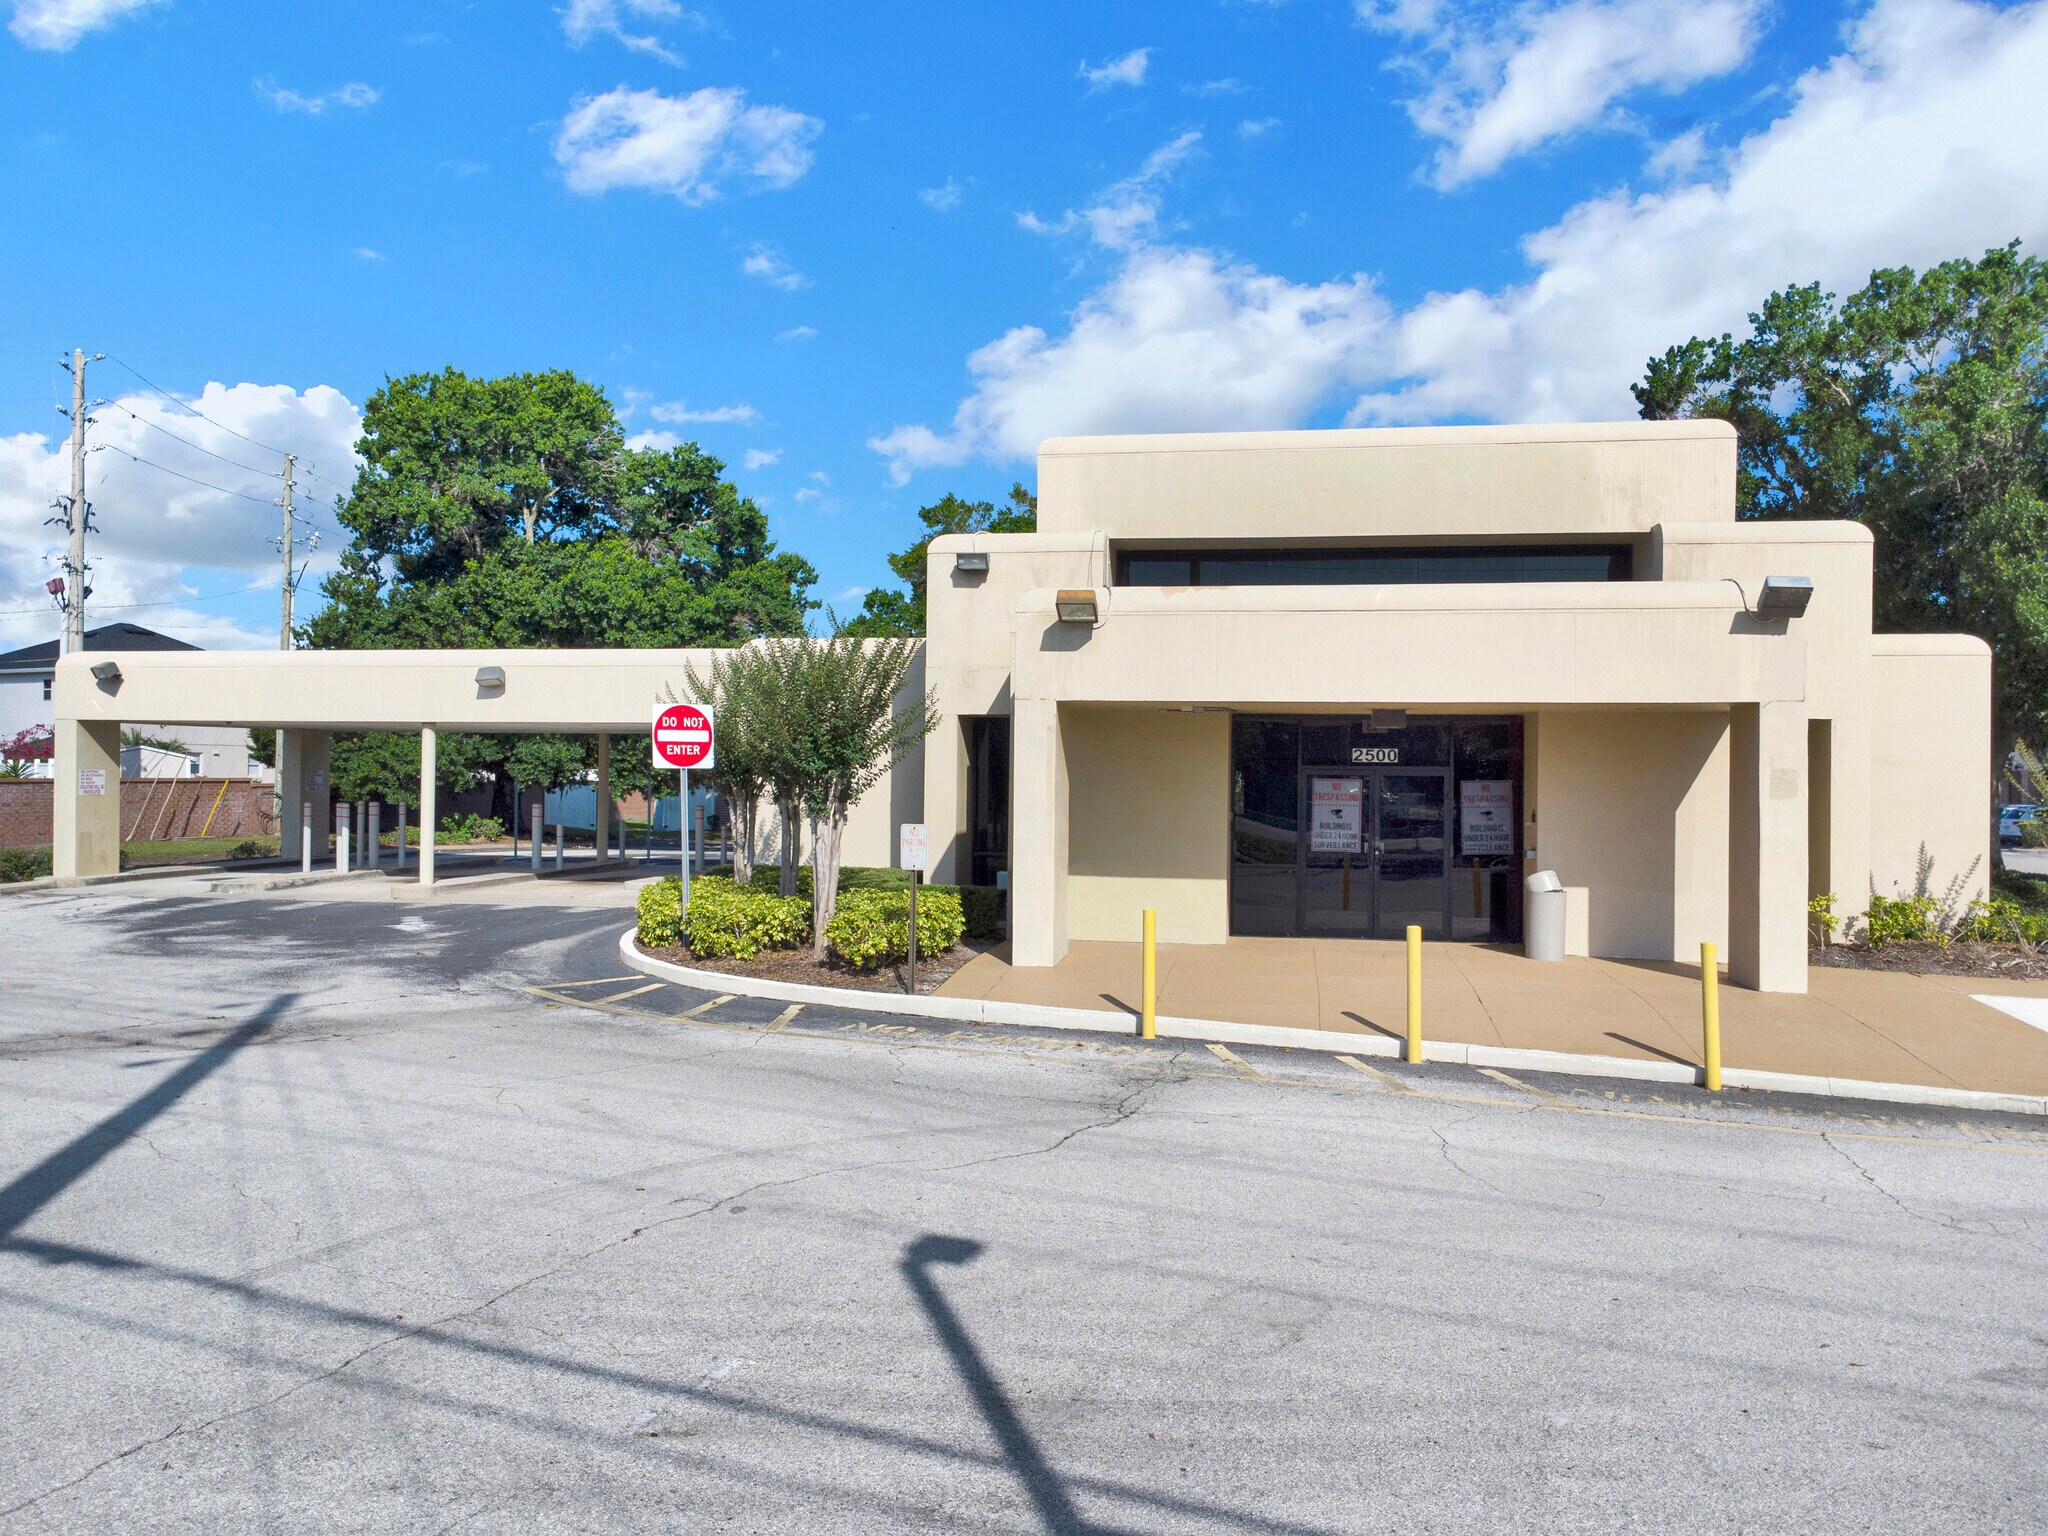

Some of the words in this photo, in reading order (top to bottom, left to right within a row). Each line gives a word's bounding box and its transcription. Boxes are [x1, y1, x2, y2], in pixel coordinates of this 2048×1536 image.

[662, 716, 677, 727] DO
[683, 717, 704, 728] NOT
[666, 744, 701, 755] ENTER
[1353, 749, 1397, 762] 2500
[1314, 793, 1359, 801] TRESPASSING
[1463, 795, 1509, 803] TRESPASSING
[910, 829, 919, 837] NO
[902, 839, 927, 847] PARING
